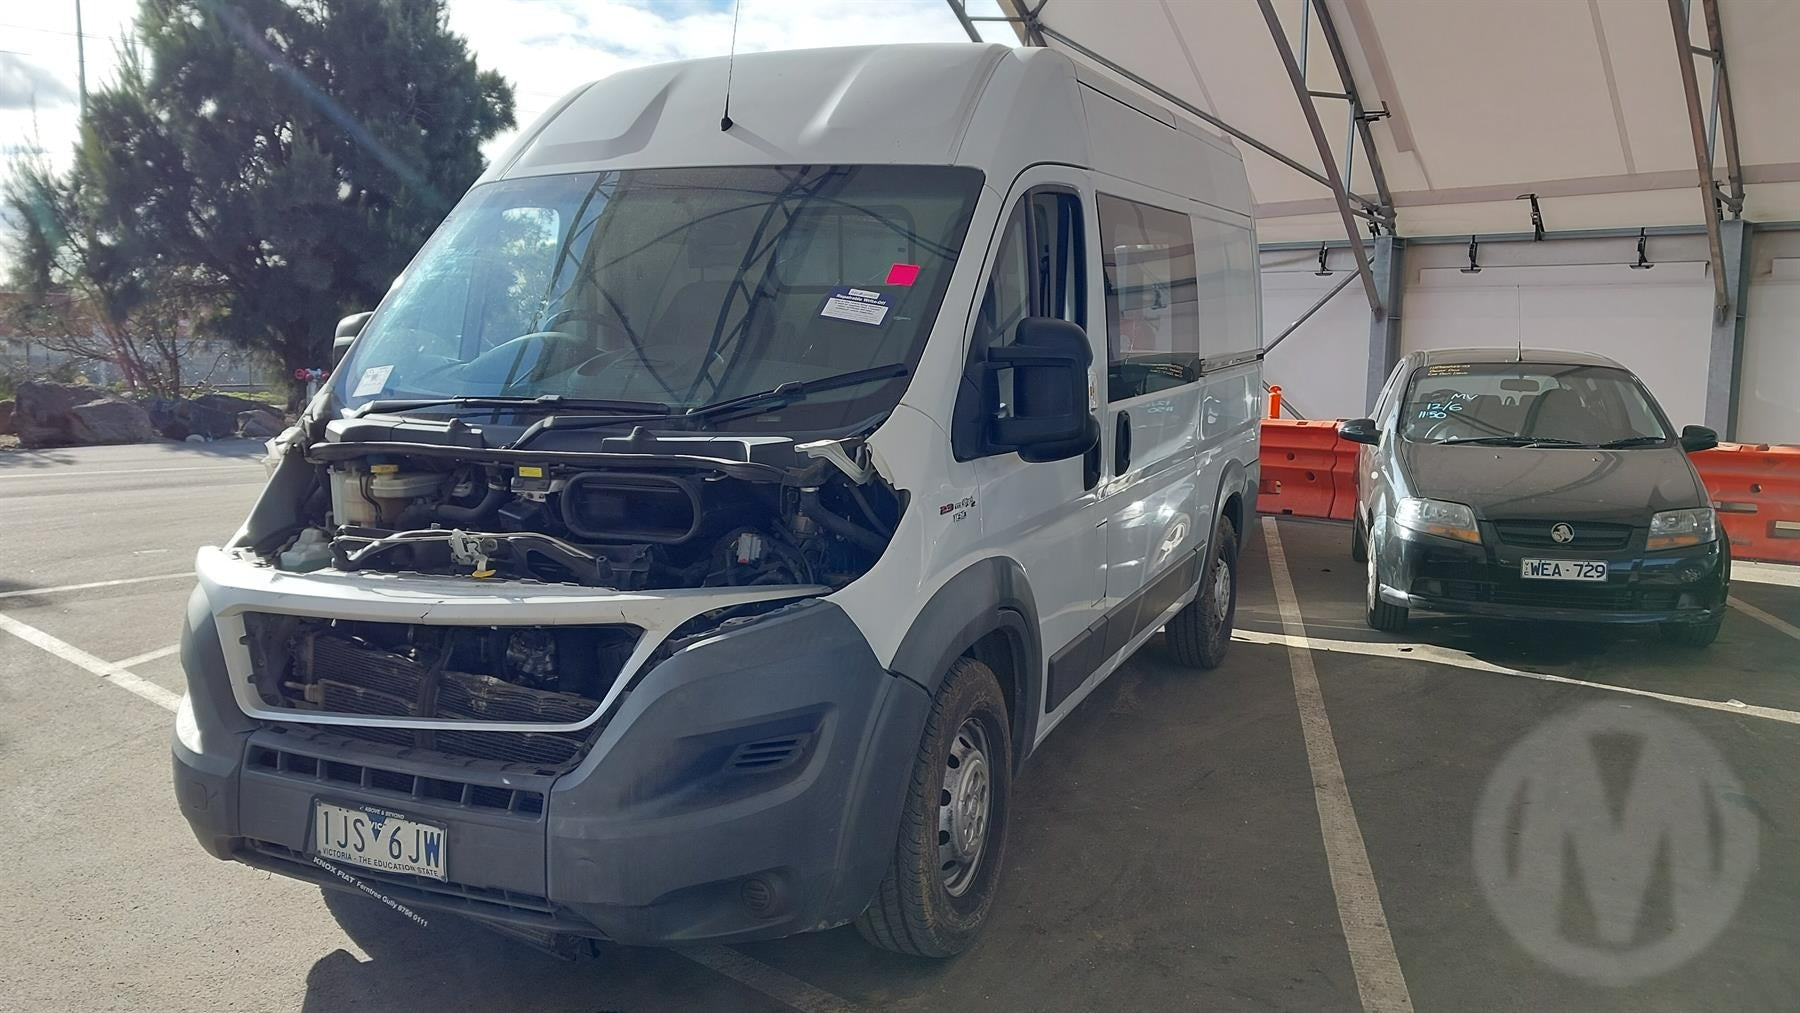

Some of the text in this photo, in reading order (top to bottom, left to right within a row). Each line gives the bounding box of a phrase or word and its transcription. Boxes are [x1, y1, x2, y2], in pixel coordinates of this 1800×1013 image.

[1427, 401, 1463, 411] 12/6
[365, 806, 381, 815] ABOVE
[323, 811, 441, 868] 1JS 6JW
[322, 847, 352, 860] VICTORIA
[359, 856, 372, 865] THE
[373, 860, 416, 873] EDUCATION
[417, 866, 439, 877] STATE
[313, 856, 336, 873] KNOX
[336, 870, 355, 884] FIAT
[356, 881, 382, 899] Ferntree
[382, 895, 398, 909] Gully
[412, 914, 428, 927] 0111
